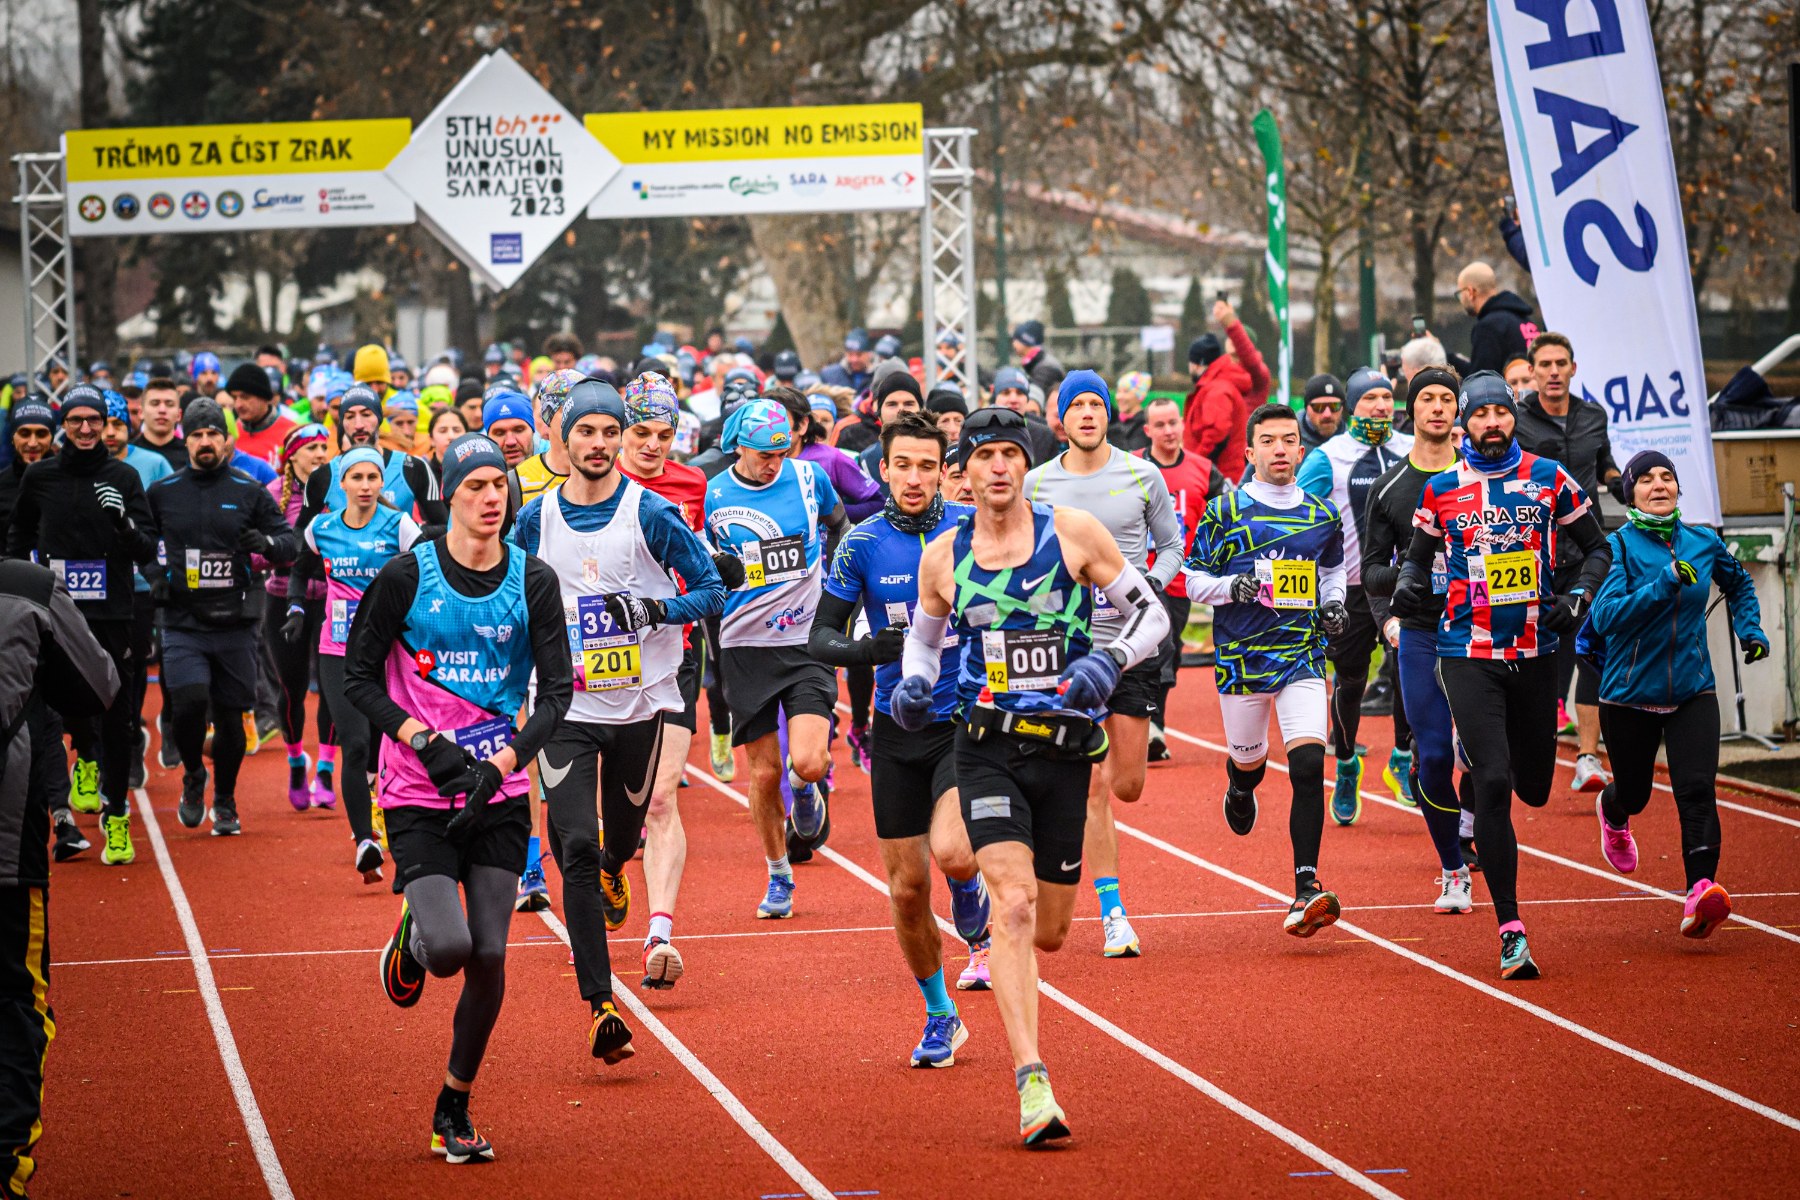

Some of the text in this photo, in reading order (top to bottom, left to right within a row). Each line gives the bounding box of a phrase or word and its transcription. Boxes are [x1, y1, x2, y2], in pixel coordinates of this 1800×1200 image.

[446, 115, 492, 136] 5TH
[643, 121, 917, 150] MY MISSION NO EMISSION
[93, 134, 353, 169] TRČIMO ZA ČIST ZRAK
[446, 137, 561, 158] UNUSUAL
[446, 159, 563, 177] MARATHON
[790, 173, 827, 185] SARA
[835, 175, 885, 189] ARGETA
[446, 178, 563, 198] SARAJEVO
[510, 196, 565, 217] 2023
[803, 465, 817, 514] IVAN
[1457, 506, 1542, 530] SARA 5K
[332, 557, 359, 567] VISIT
[766, 549, 800, 571] 019
[202, 561, 232, 577] 022
[749, 570, 763, 581] 42
[68, 572, 102, 589] 322
[188, 574, 198, 583] 42
[1279, 574, 1309, 594] 210
[1433, 575, 1447, 585] 10
[1491, 566, 1531, 590] 228
[1260, 585, 1273, 602] A
[1472, 584, 1488, 601] A
[334, 623, 345, 634] 10
[497, 624, 512, 636] CR
[583, 610, 622, 635] 39
[419, 654, 432, 665] SA
[437, 650, 479, 665] VISIT
[590, 649, 632, 674] 201
[1012, 645, 1058, 674] 001
[989, 670, 1005, 684] 42
